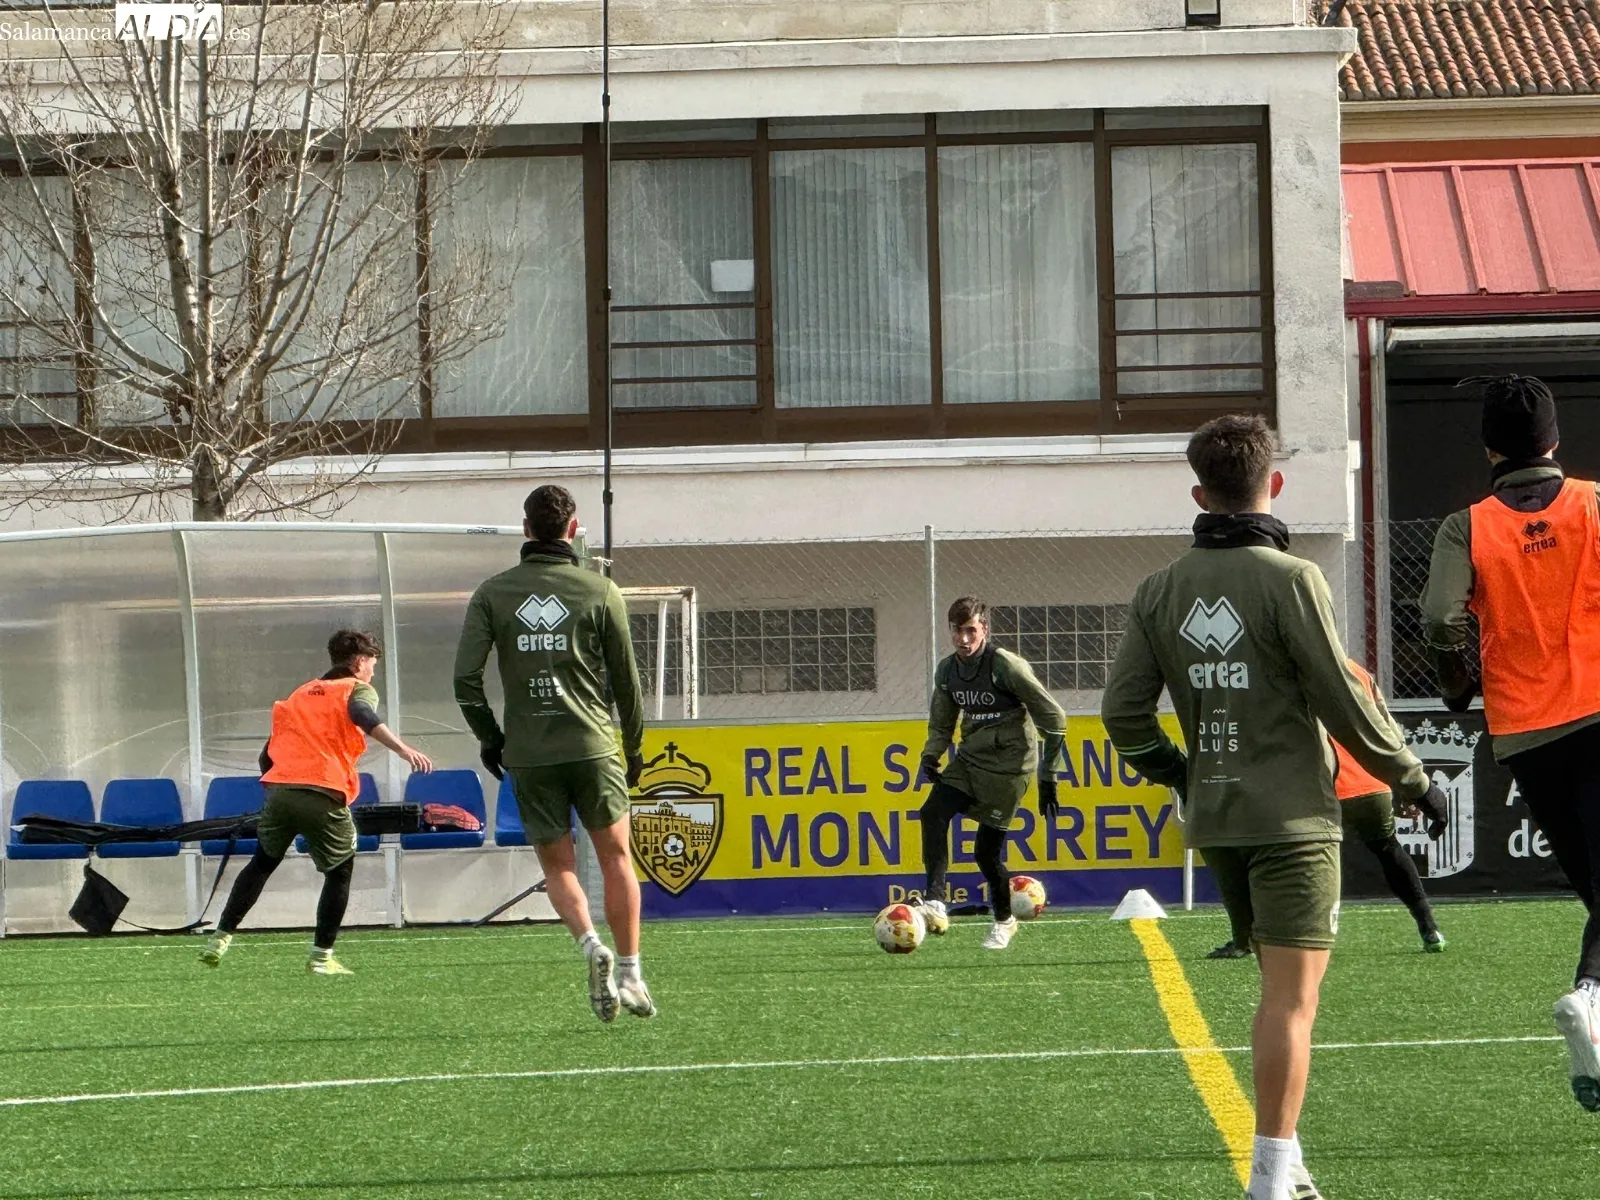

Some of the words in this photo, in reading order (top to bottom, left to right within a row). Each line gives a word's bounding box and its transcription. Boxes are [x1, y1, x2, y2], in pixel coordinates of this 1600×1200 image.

[1523, 537, 1557, 554] errea
[517, 633, 568, 652] errea
[744, 745, 867, 797] REAL
[751, 804, 1172, 870] MONERREY
